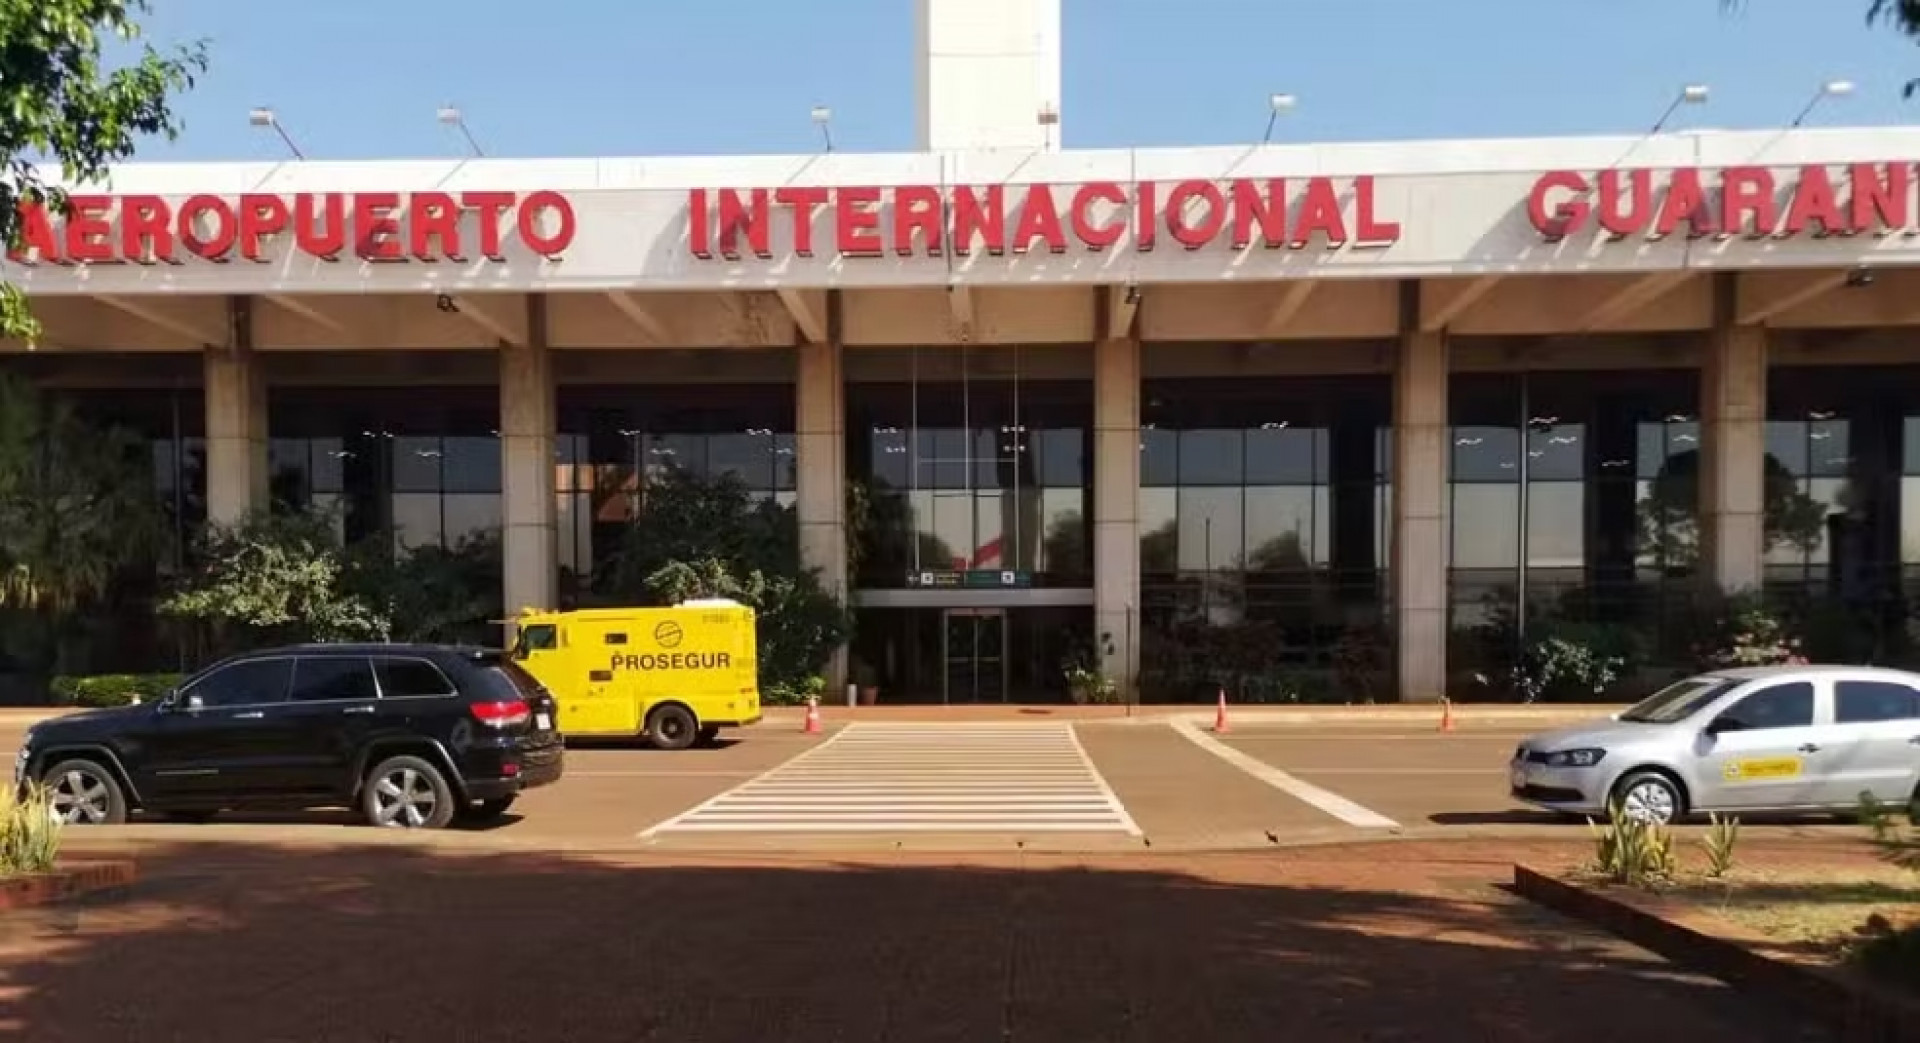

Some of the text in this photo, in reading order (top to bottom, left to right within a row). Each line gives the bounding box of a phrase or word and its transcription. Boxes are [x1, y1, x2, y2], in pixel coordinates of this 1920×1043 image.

[6, 160, 1920, 263] AEROPUERTO INTERNACIONAL GUARAN
[611, 652, 731, 670] PROSEGUR
